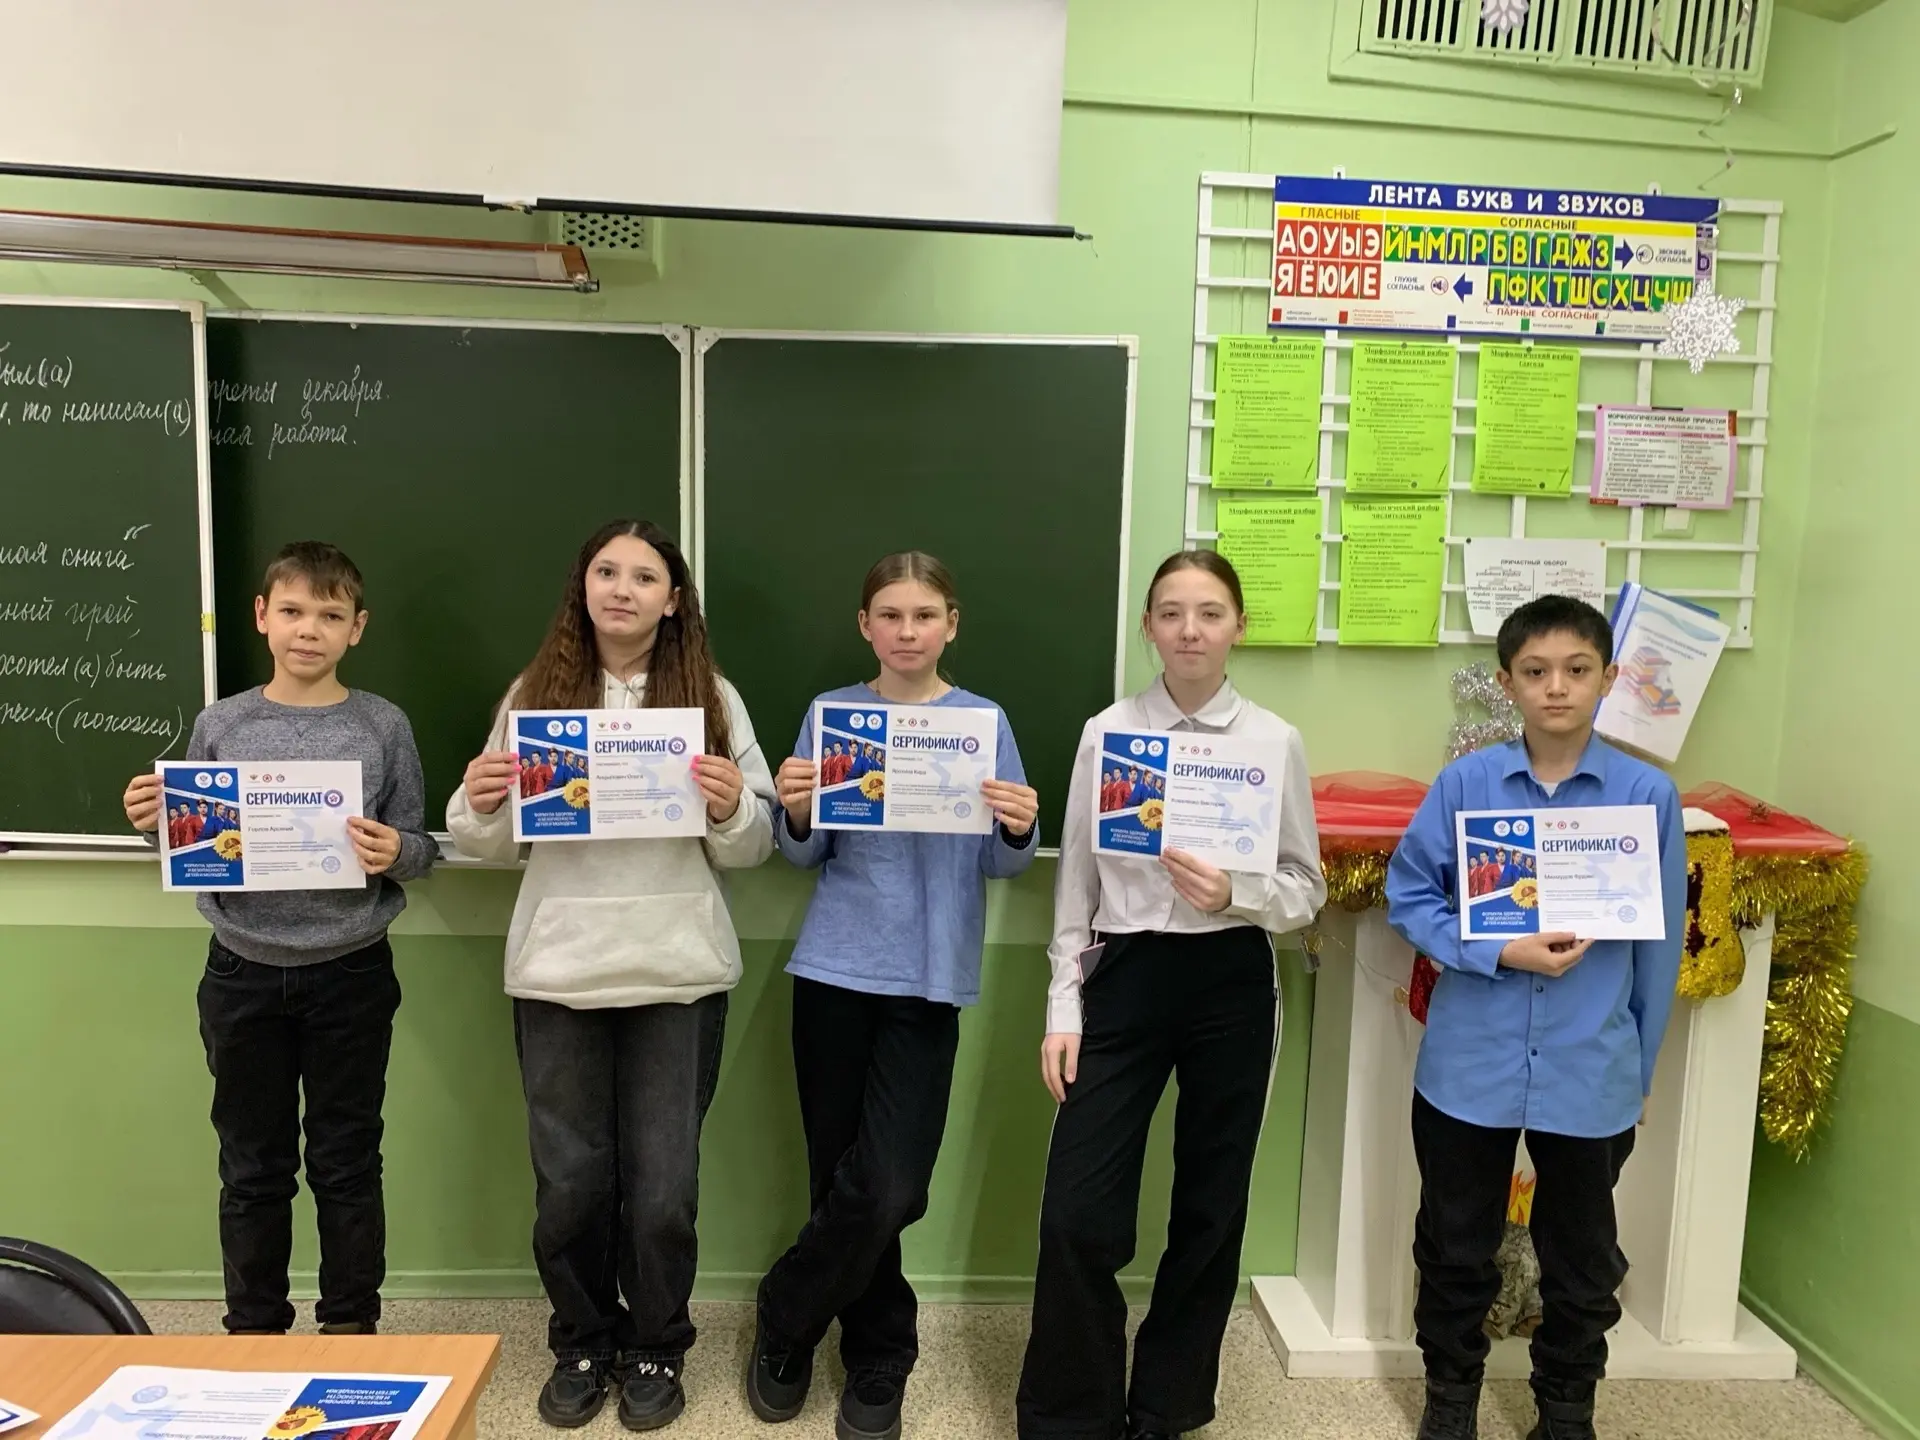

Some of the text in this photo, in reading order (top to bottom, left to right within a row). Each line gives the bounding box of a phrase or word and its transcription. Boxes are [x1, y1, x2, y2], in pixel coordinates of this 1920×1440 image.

[1368, 184, 1645, 216] ЛЕНТА БУКВ И ЗВУКОВ
[1300, 207, 1361, 221] ГЛАСНЫЕ
[1500, 217, 1578, 231] СОГЛАСНЫЕ
[1496, 307, 1600, 320] ПАРНЫЕ СОГЛАСНЫЕ
[1293, 343, 1316, 352] разбор
[1607, 413, 1666, 422] МОРФОЛОГИЧЕСКИЙ
[1667, 415, 1690, 423] РАЗБОР
[1293, 508, 1316, 516] разбор
[1416, 504, 1440, 513] разбор
[1500, 558, 1541, 566] ПРИЧАСТНЫЙ
[594, 739, 667, 754] СЕРТИФИКАТ
[892, 735, 961, 751] СЕРТИФИКАТ
[1173, 763, 1246, 782] СЕРТИФИКАТ
[246, 791, 323, 806] СЕРТИФИКАТ
[1542, 837, 1617, 853] СЕРТИФИКАТ
